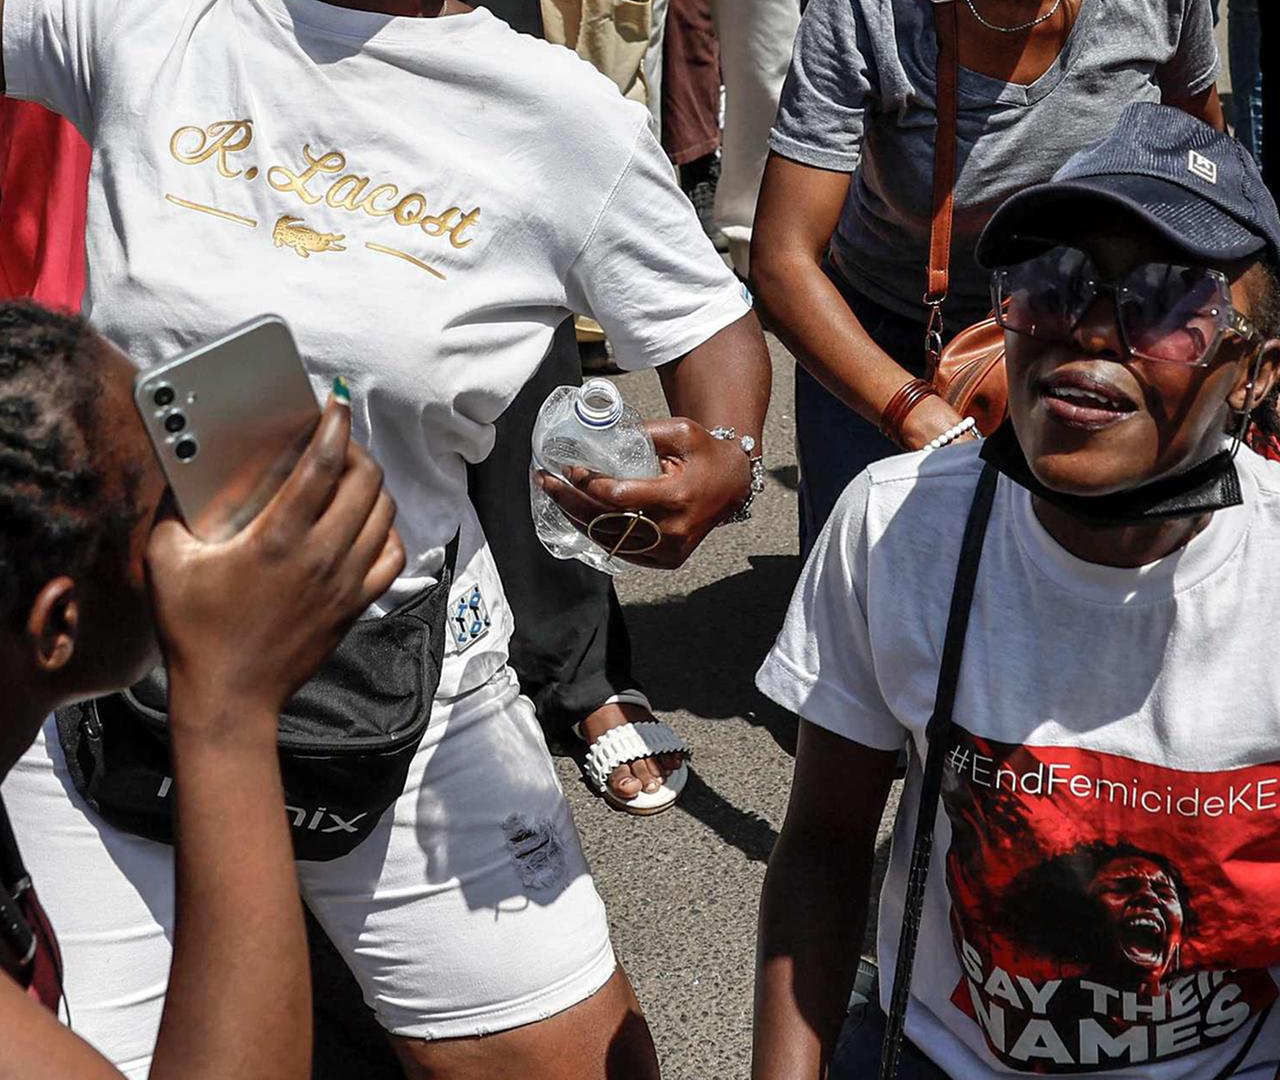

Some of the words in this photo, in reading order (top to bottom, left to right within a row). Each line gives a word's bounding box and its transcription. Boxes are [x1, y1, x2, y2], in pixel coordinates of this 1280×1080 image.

[169, 119, 260, 181] R.
[267, 143, 481, 249] Lacost
[948, 744, 1278, 817] #EndFemicideKE
[960, 937, 1062, 1015] SAY
[969, 982, 1252, 1066] NAMES
